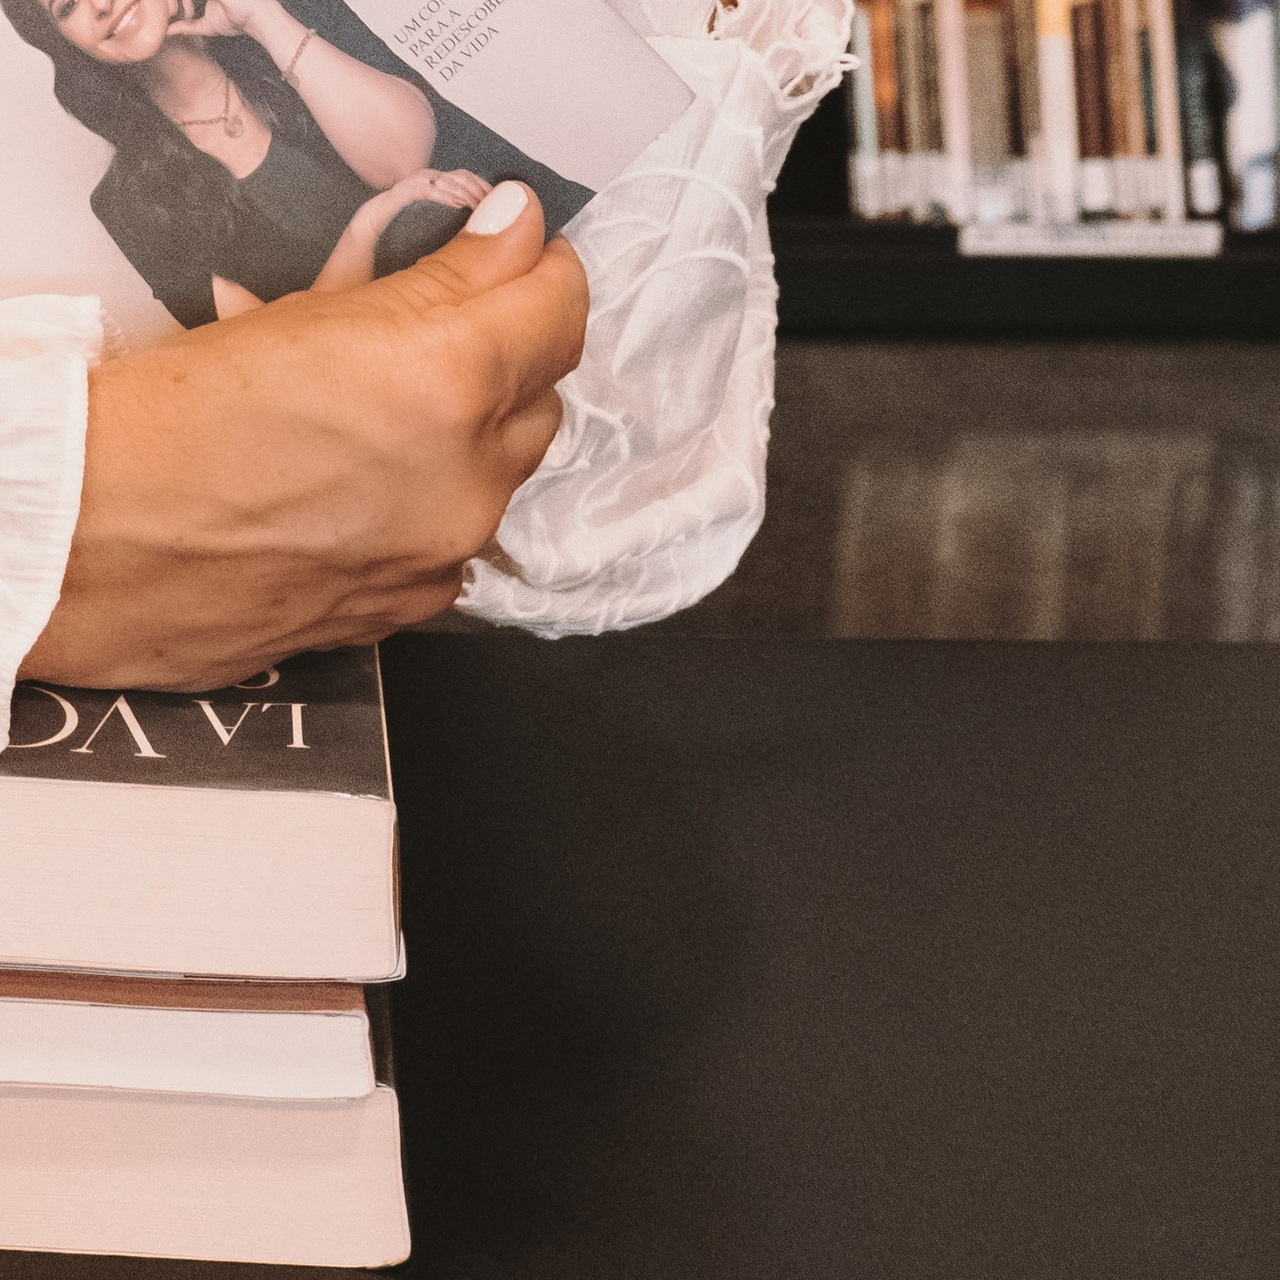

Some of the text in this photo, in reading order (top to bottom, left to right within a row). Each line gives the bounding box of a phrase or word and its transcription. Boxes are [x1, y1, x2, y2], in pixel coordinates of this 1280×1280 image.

[393, 18, 422, 44] UM
[408, 9, 461, 58] PARA A
[439, 26, 499, 82] DA VIDA
[194, 698, 311, 749] LA
